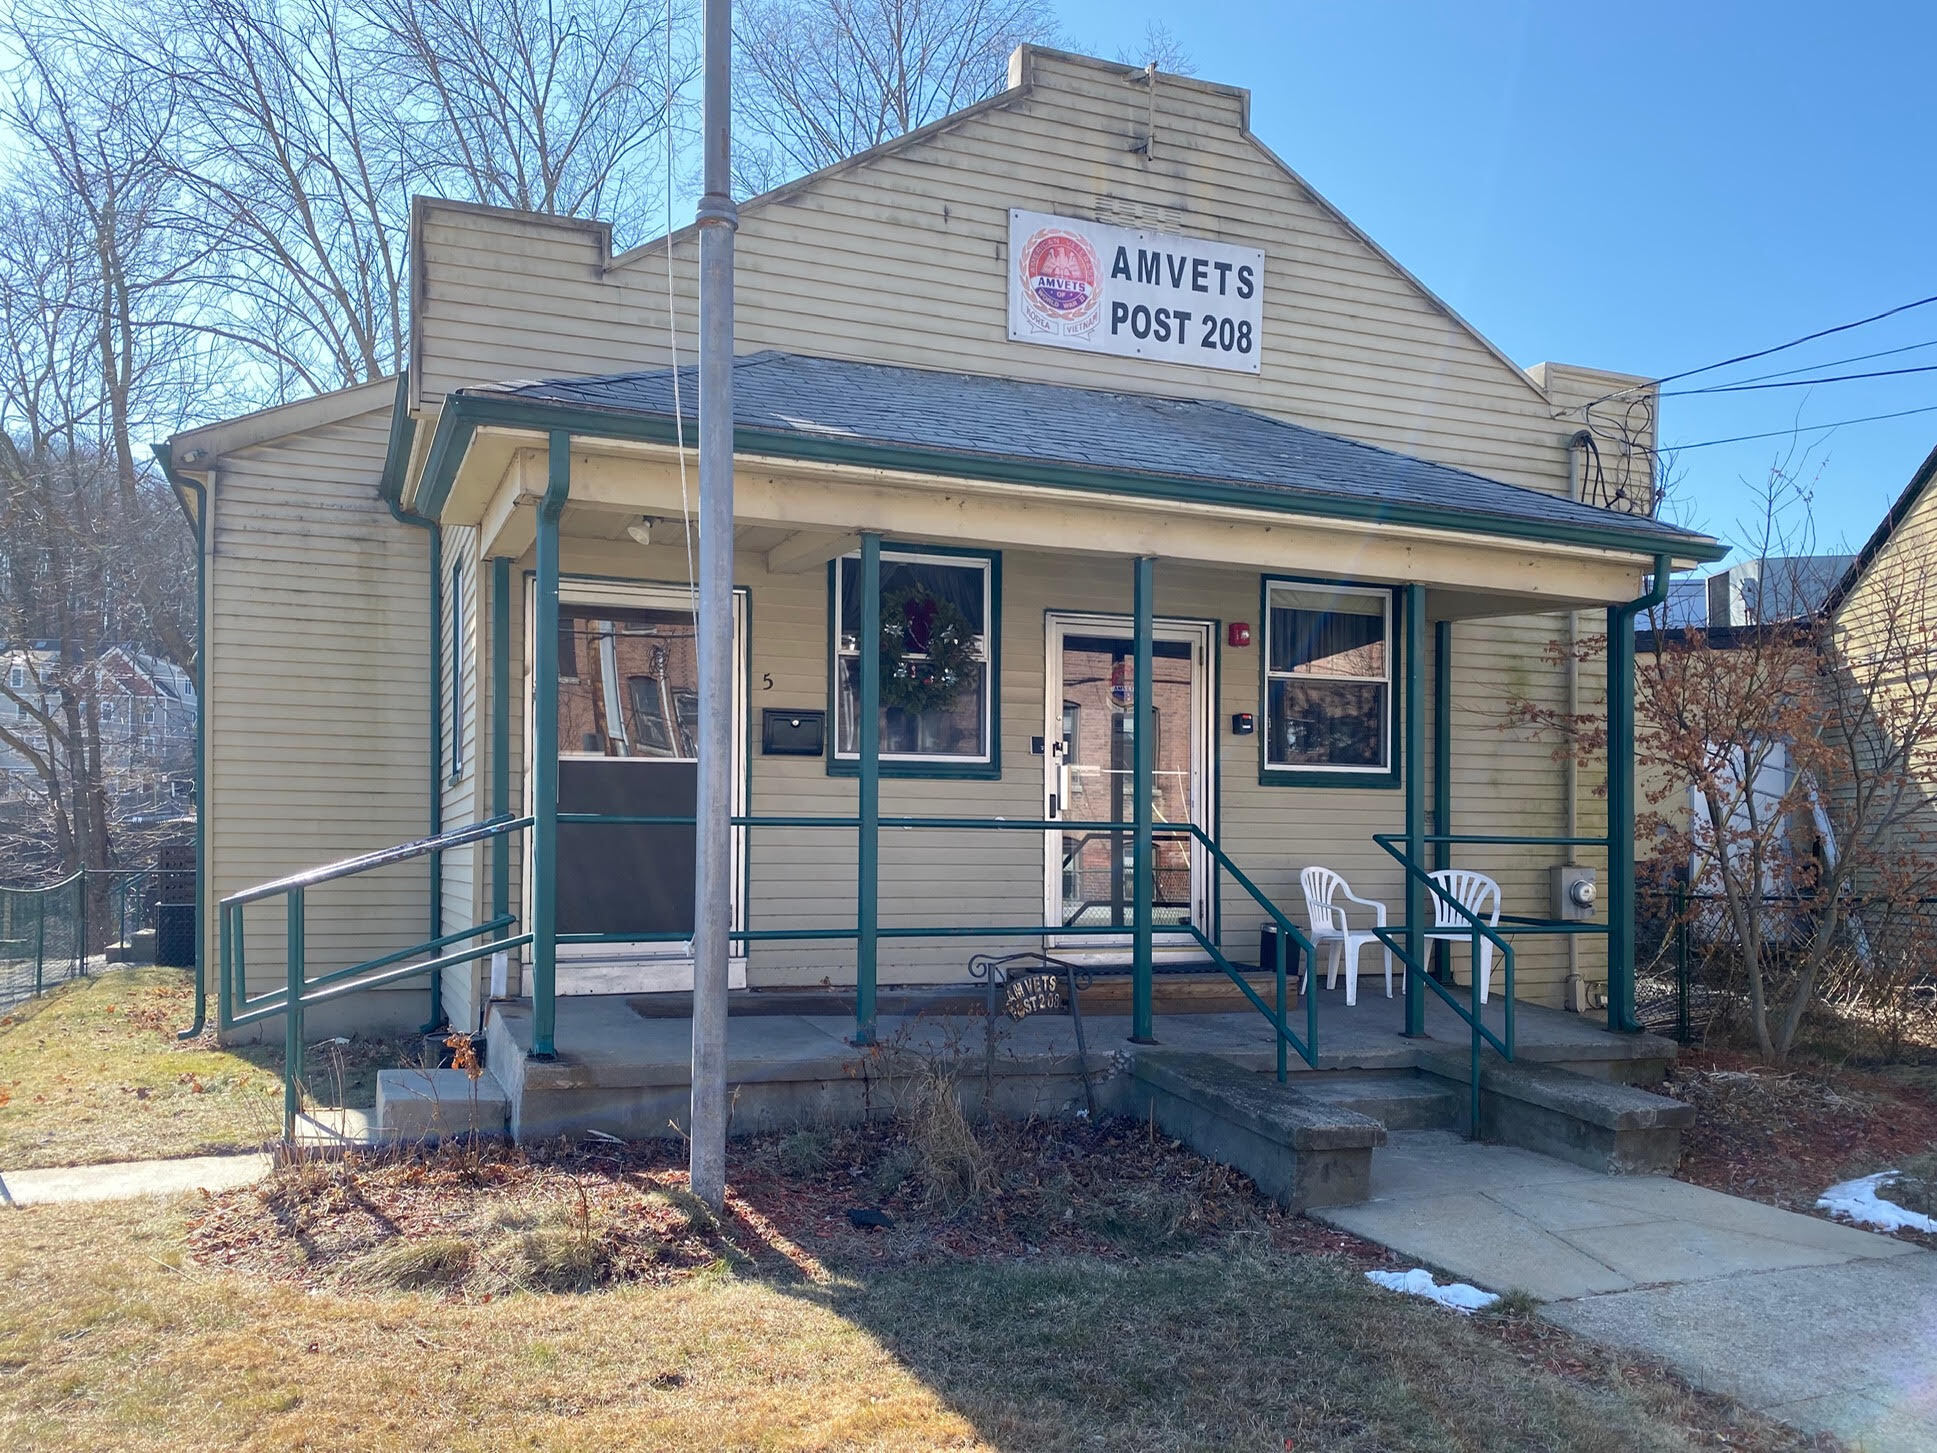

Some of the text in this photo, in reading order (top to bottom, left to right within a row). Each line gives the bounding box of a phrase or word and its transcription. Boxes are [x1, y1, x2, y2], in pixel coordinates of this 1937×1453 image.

[1111, 246, 1254, 299] AMVETS
[1038, 277, 1086, 292] AMVETS
[1038, 290, 1060, 307] WORLD
[1063, 301, 1078, 309] WAR
[1026, 306, 1050, 330] KOREA
[1067, 312, 1098, 333] VIETNAM
[1111, 301, 1252, 354] POST 208
[763, 672, 774, 690] 5
[1007, 975, 1057, 1001] AMVETS
[1039, 993, 1060, 1008] 208
